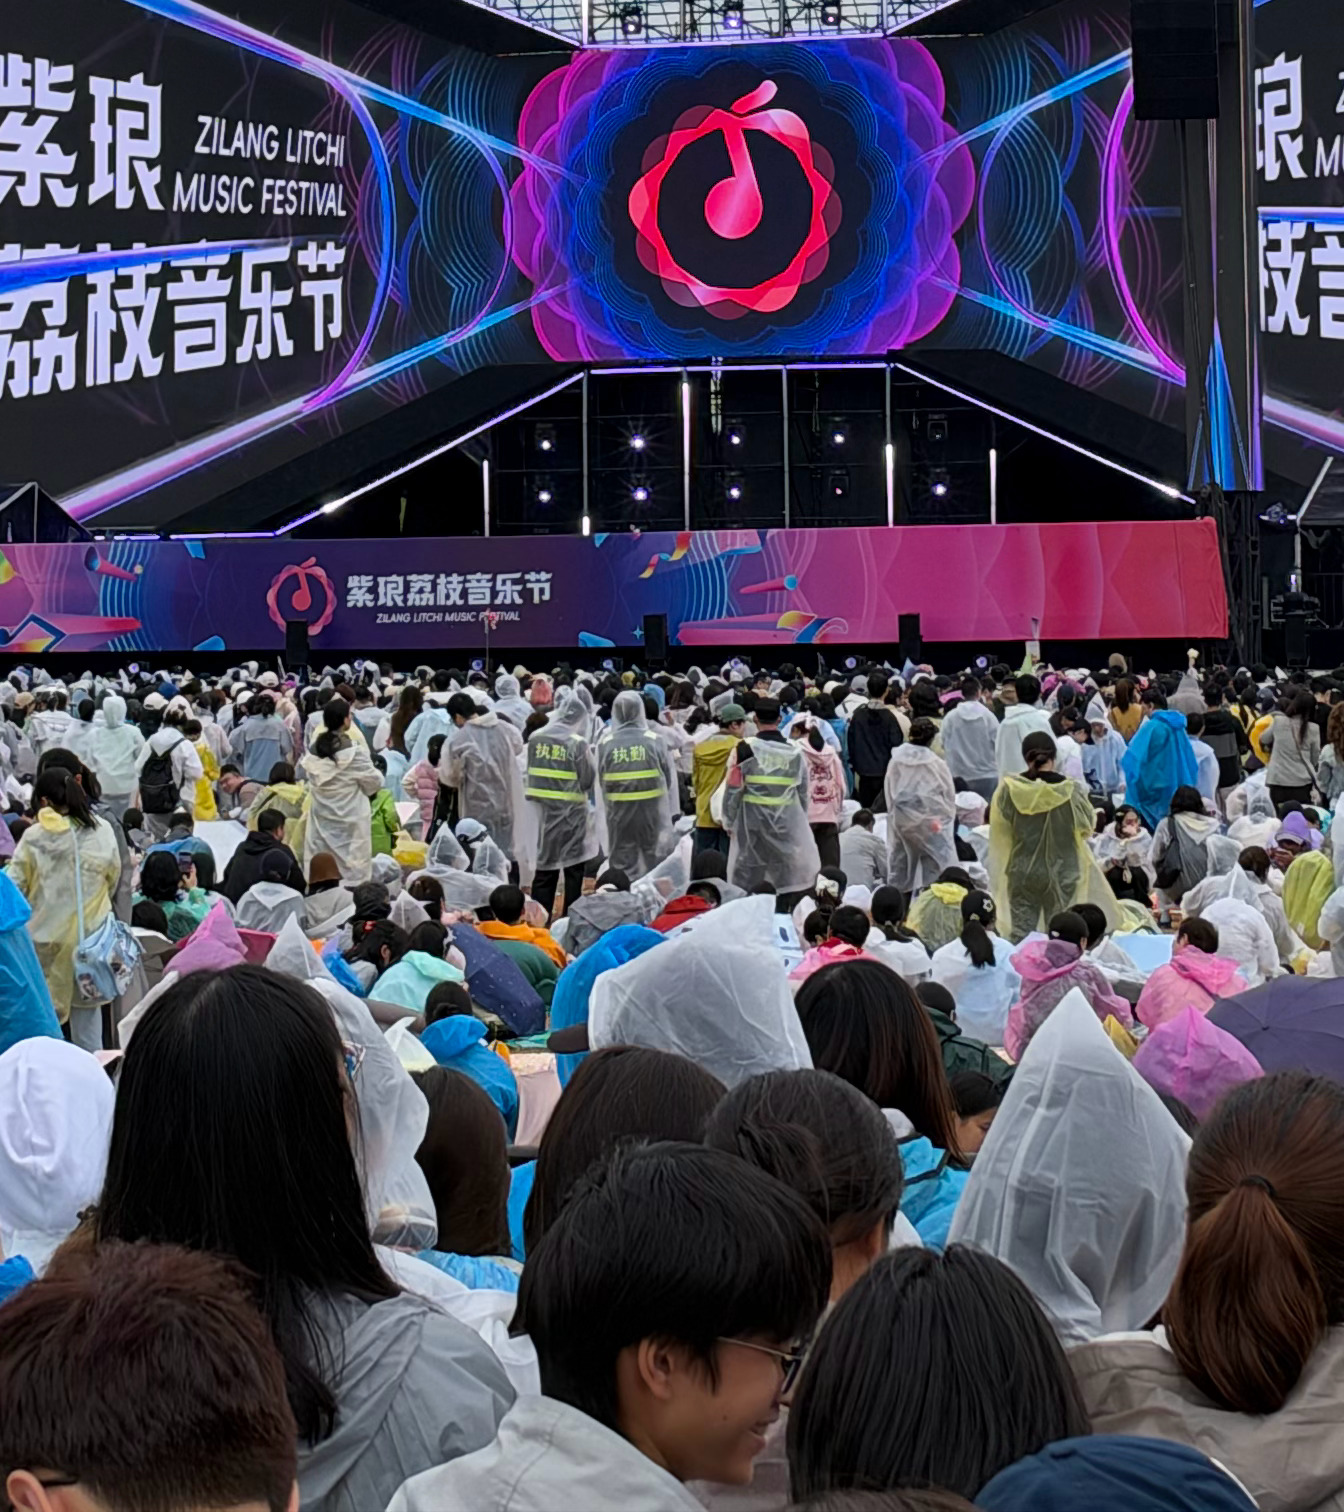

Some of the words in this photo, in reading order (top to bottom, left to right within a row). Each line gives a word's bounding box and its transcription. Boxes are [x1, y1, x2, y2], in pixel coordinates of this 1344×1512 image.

[195, 115, 280, 162] ZILANG
[285, 129, 346, 168] LITCHI
[172, 171, 255, 215] MUSIC
[261, 178, 347, 217] FESTIVAL
[346, 571, 553, 608] 紫琅荔枝音乐节
[376, 613, 411, 624] ZILANG
[413, 612, 443, 623] LITCHI
[444, 611, 476, 622] MUSIC
[536, 743, 567, 762] 执勤
[613, 744, 646, 763] 执勤
